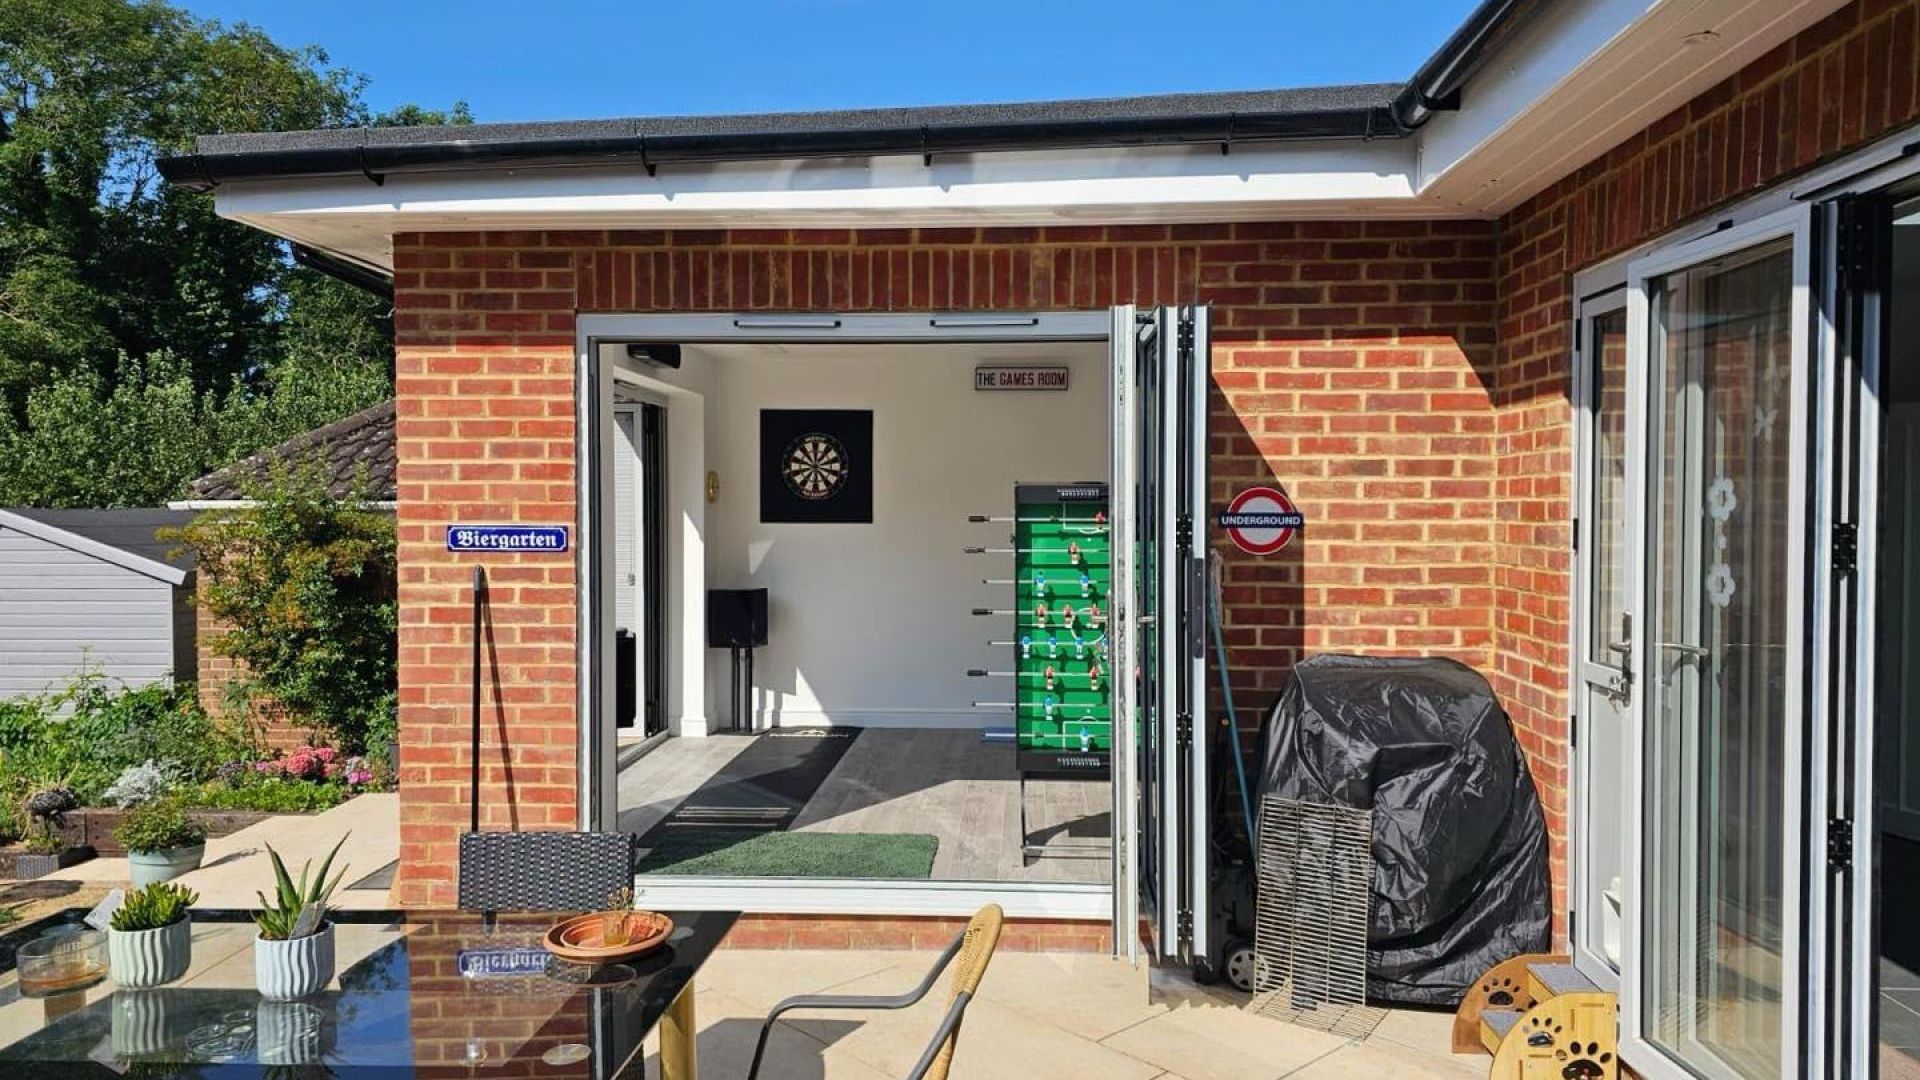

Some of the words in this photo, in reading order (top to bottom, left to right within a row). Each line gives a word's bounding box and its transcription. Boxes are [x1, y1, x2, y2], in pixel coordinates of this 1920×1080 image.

[977, 372, 996, 386] THE
[999, 372, 1034, 386] GAMES
[1038, 372, 1066, 386] ROOM
[1221, 515, 1301, 525] UNDERGROUND
[457, 530, 557, 549] Biergarten
